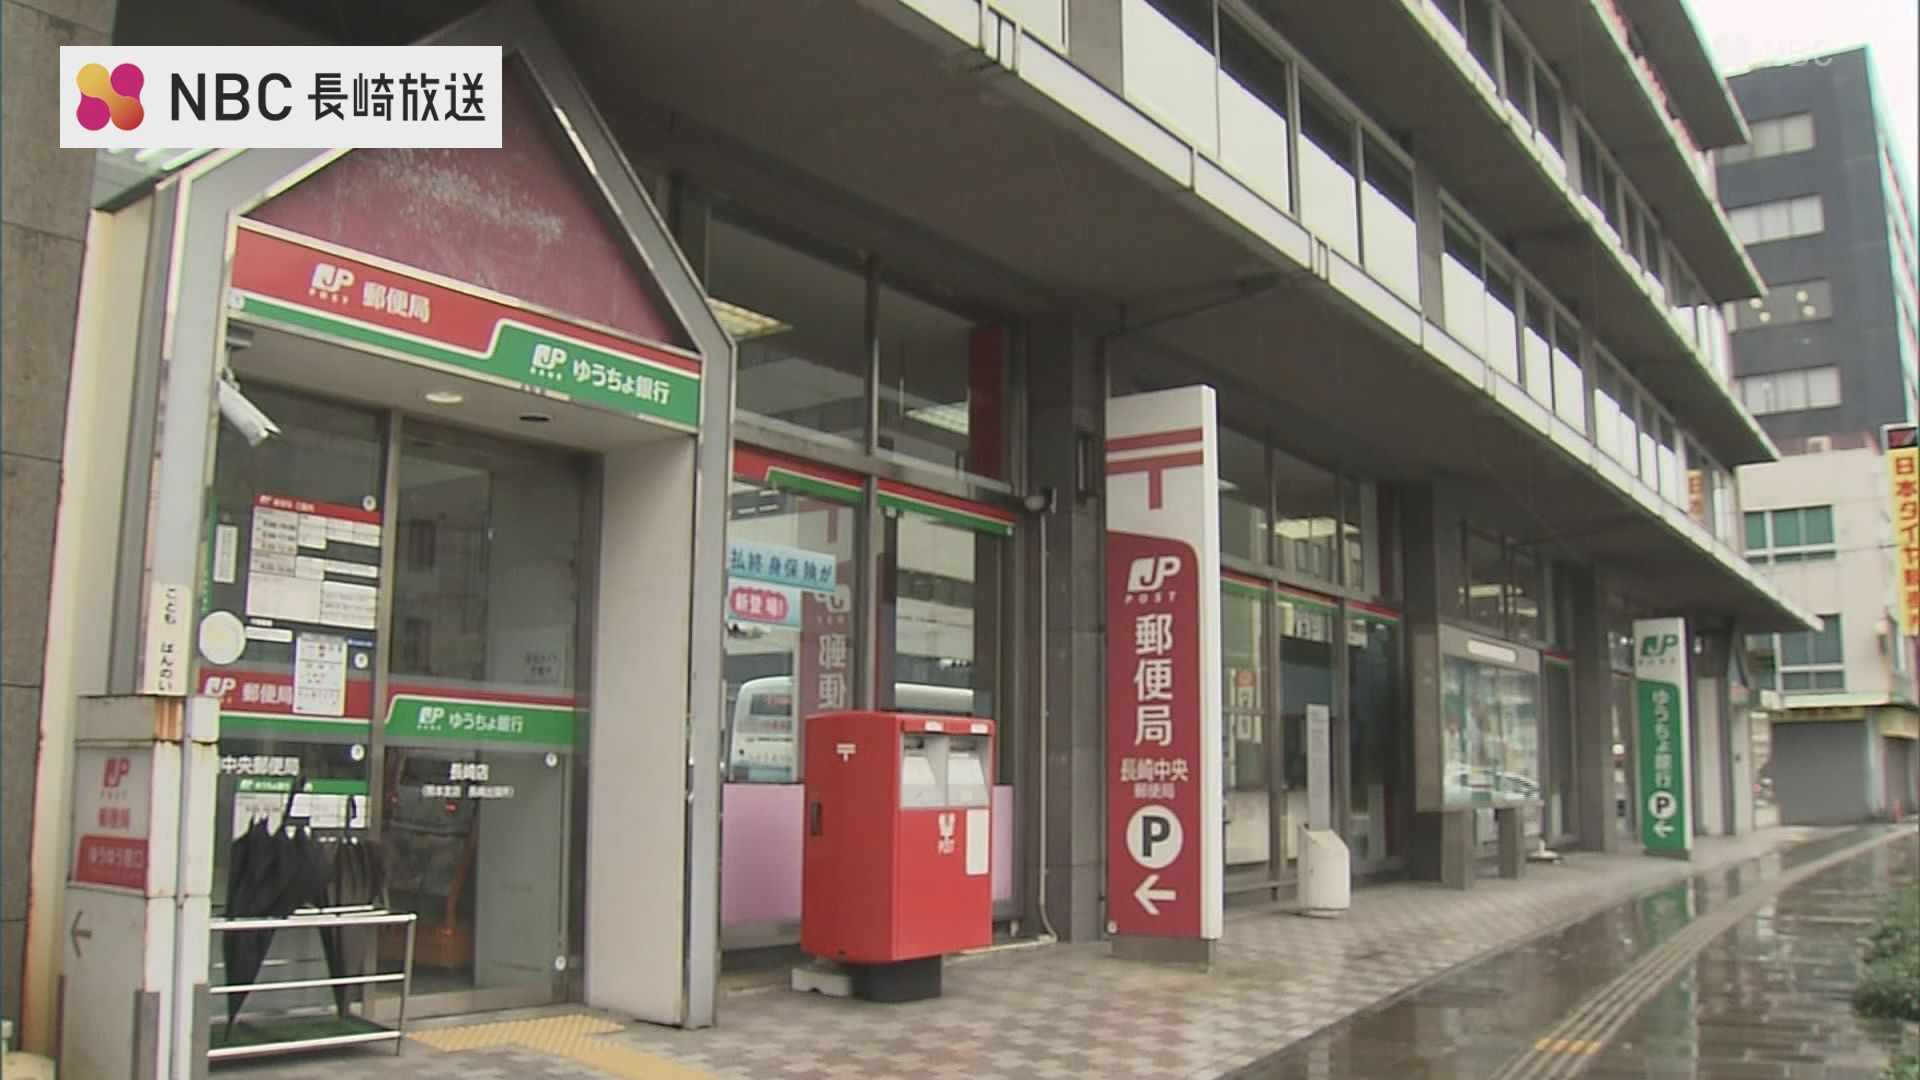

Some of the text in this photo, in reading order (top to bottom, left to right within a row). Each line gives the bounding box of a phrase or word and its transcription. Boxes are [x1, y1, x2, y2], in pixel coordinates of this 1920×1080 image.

[362, 281, 430, 323] 郵便局
[573, 359, 670, 405] ゆうちょ銀行
[1127, 556, 1181, 592] JP
[1125, 591, 1177, 604] POST
[1134, 613, 1173, 747] 郵便局
[449, 712, 524, 733] ゆうちょ銀行
[220, 754, 300, 777] 中央郵便局
[1120, 758, 1188, 782] 長崎中央
[1656, 797, 1670, 814] P
[1142, 815, 1171, 857] P
